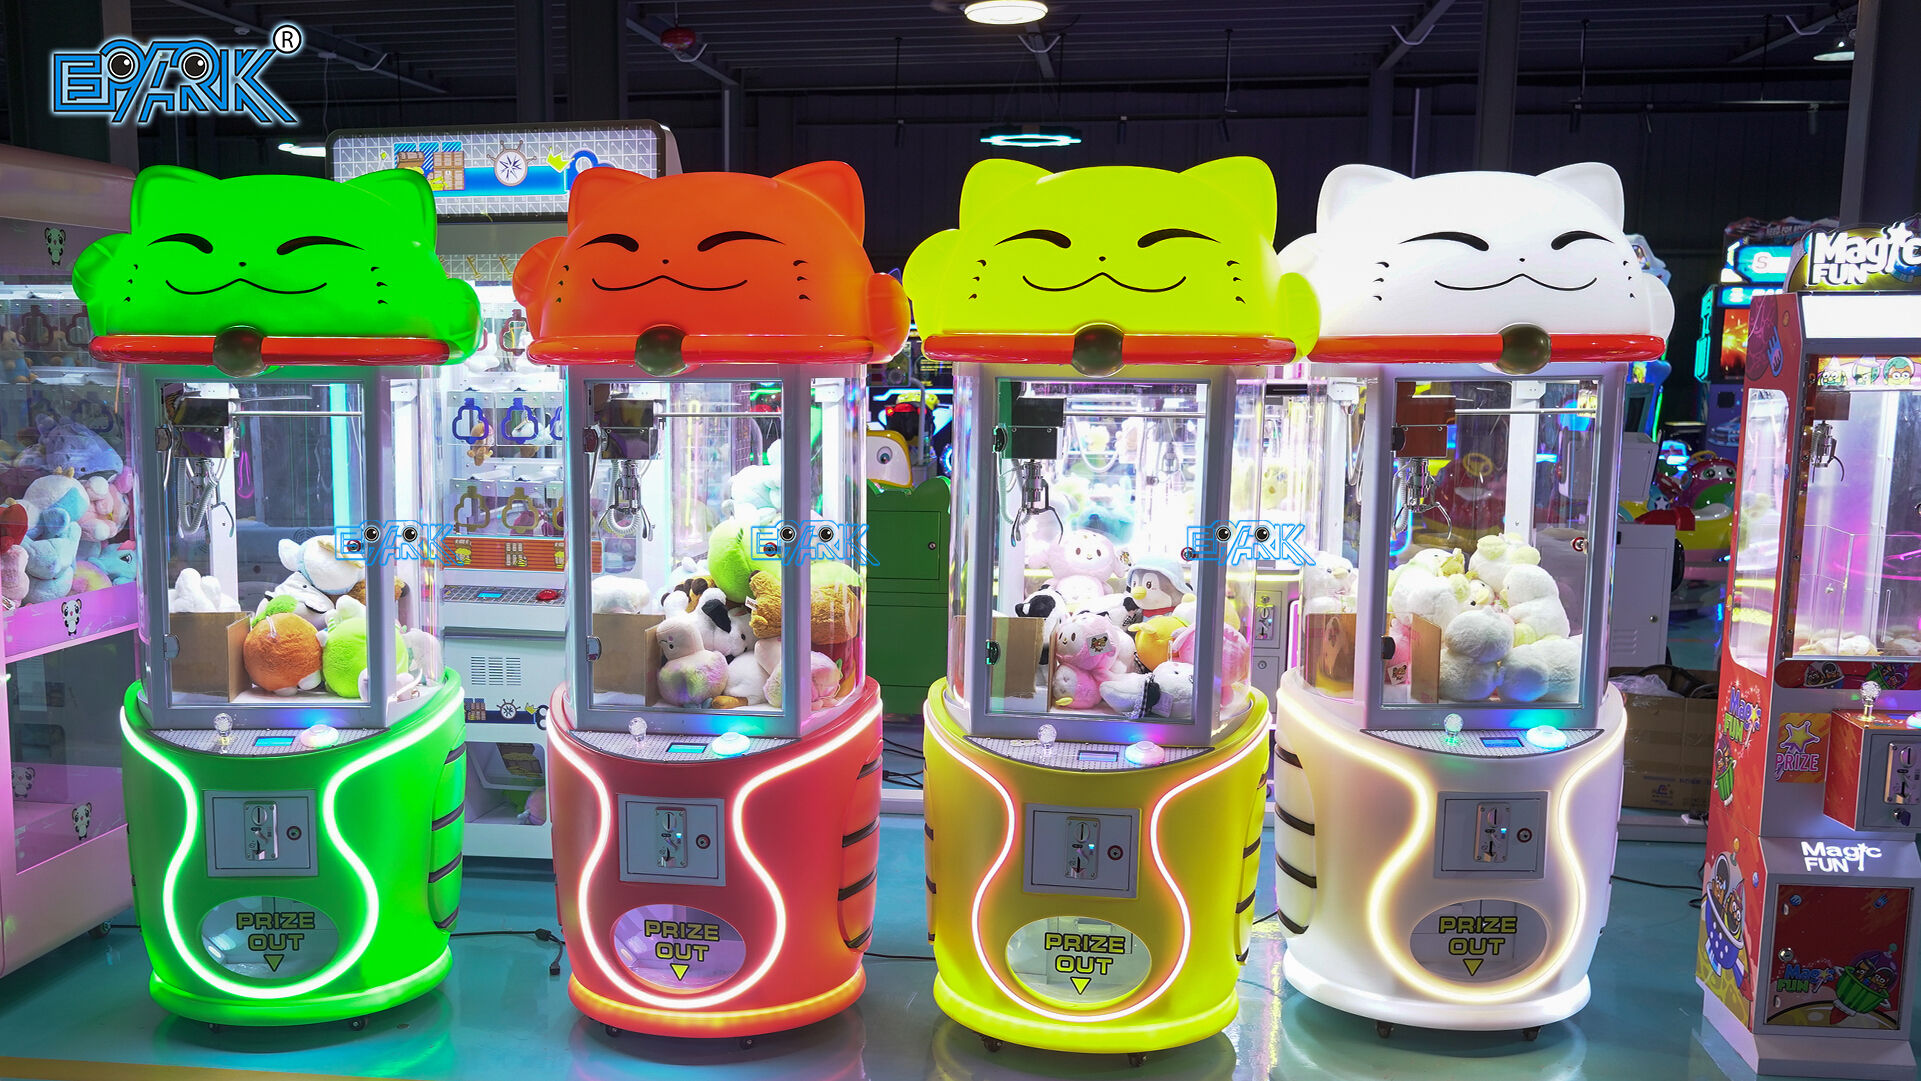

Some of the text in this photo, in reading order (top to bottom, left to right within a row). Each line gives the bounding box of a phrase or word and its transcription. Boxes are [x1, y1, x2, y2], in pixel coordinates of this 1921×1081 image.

[1812, 263, 1868, 285] FUN
[1723, 711, 1744, 744] FUN
[1776, 753, 1820, 772] PRIZE
[1801, 842, 1882, 871] Magic
[1804, 857, 1849, 872] FUN
[236, 912, 315, 931] PRIZE
[644, 920, 720, 942] PRIZE
[1439, 916, 1517, 933] PRIZE
[248, 933, 304, 951] OUT
[1045, 933, 1126, 954] PRIZE
[1449, 938, 1505, 955] OUT
[655, 942, 709, 962] OUT
[1055, 955, 1113, 975] OUT
[1777, 979, 1809, 993] FUN
